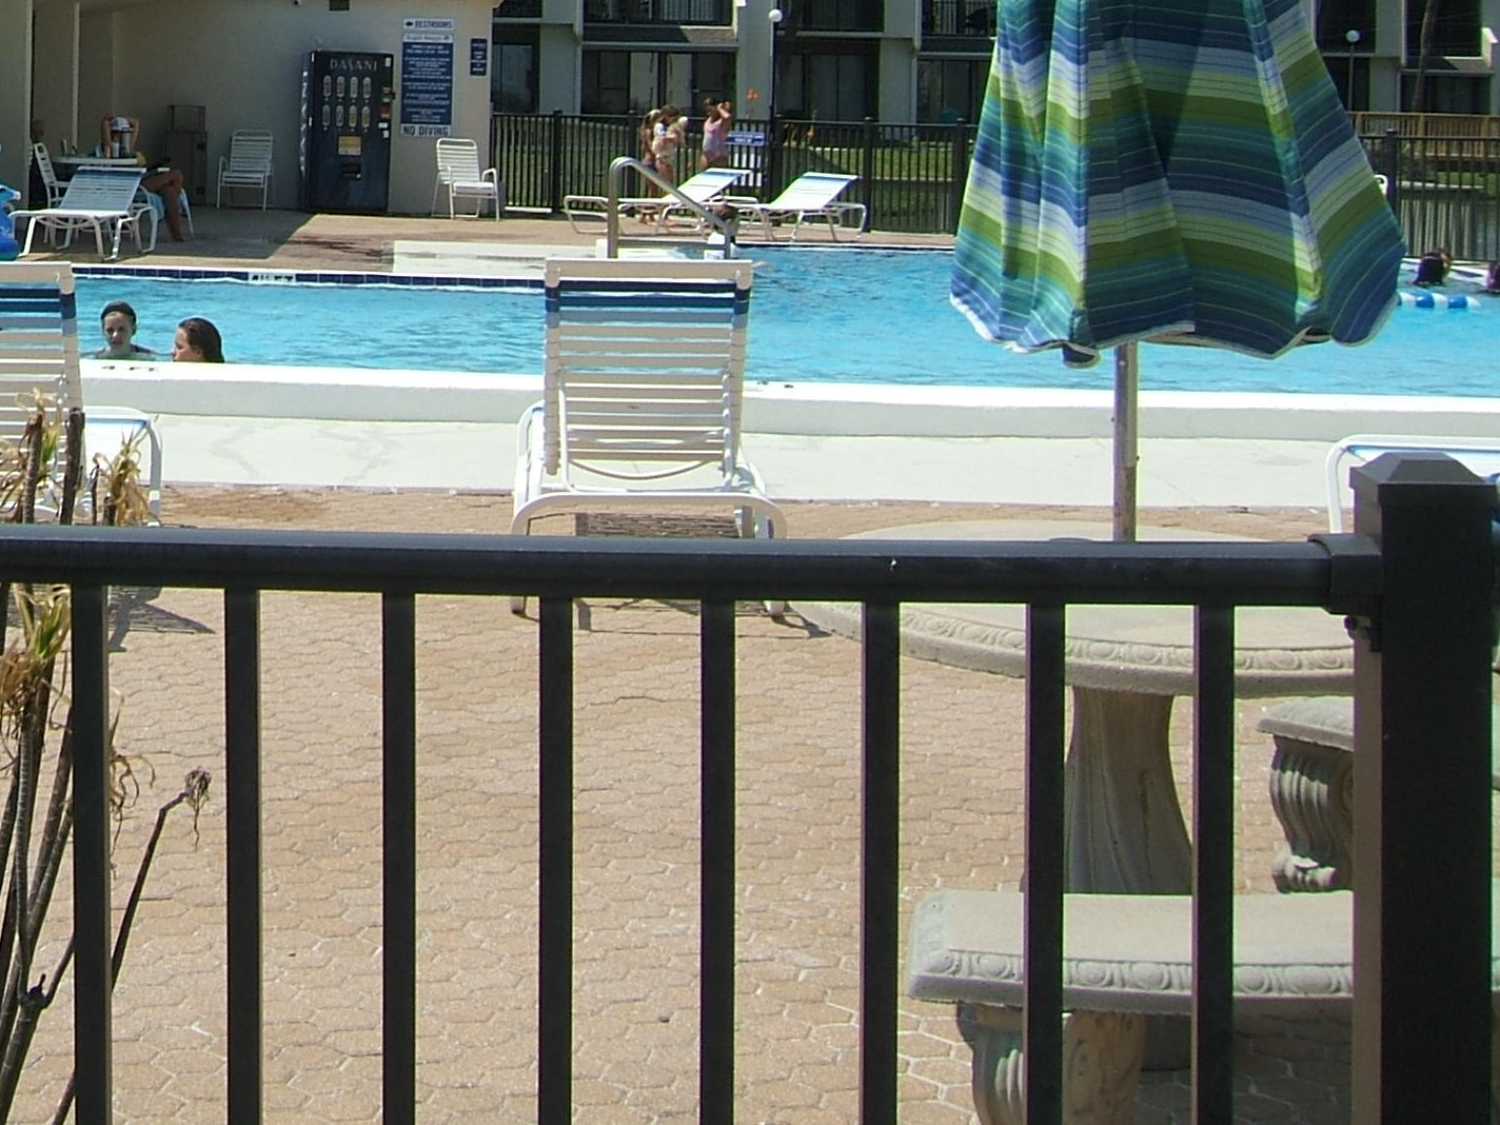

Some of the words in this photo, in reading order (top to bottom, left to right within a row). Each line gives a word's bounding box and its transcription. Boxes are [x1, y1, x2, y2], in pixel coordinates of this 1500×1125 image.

[330, 59, 378, 71] DASANI
[402, 126, 416, 136] NO
[418, 126, 449, 136] DIVING
